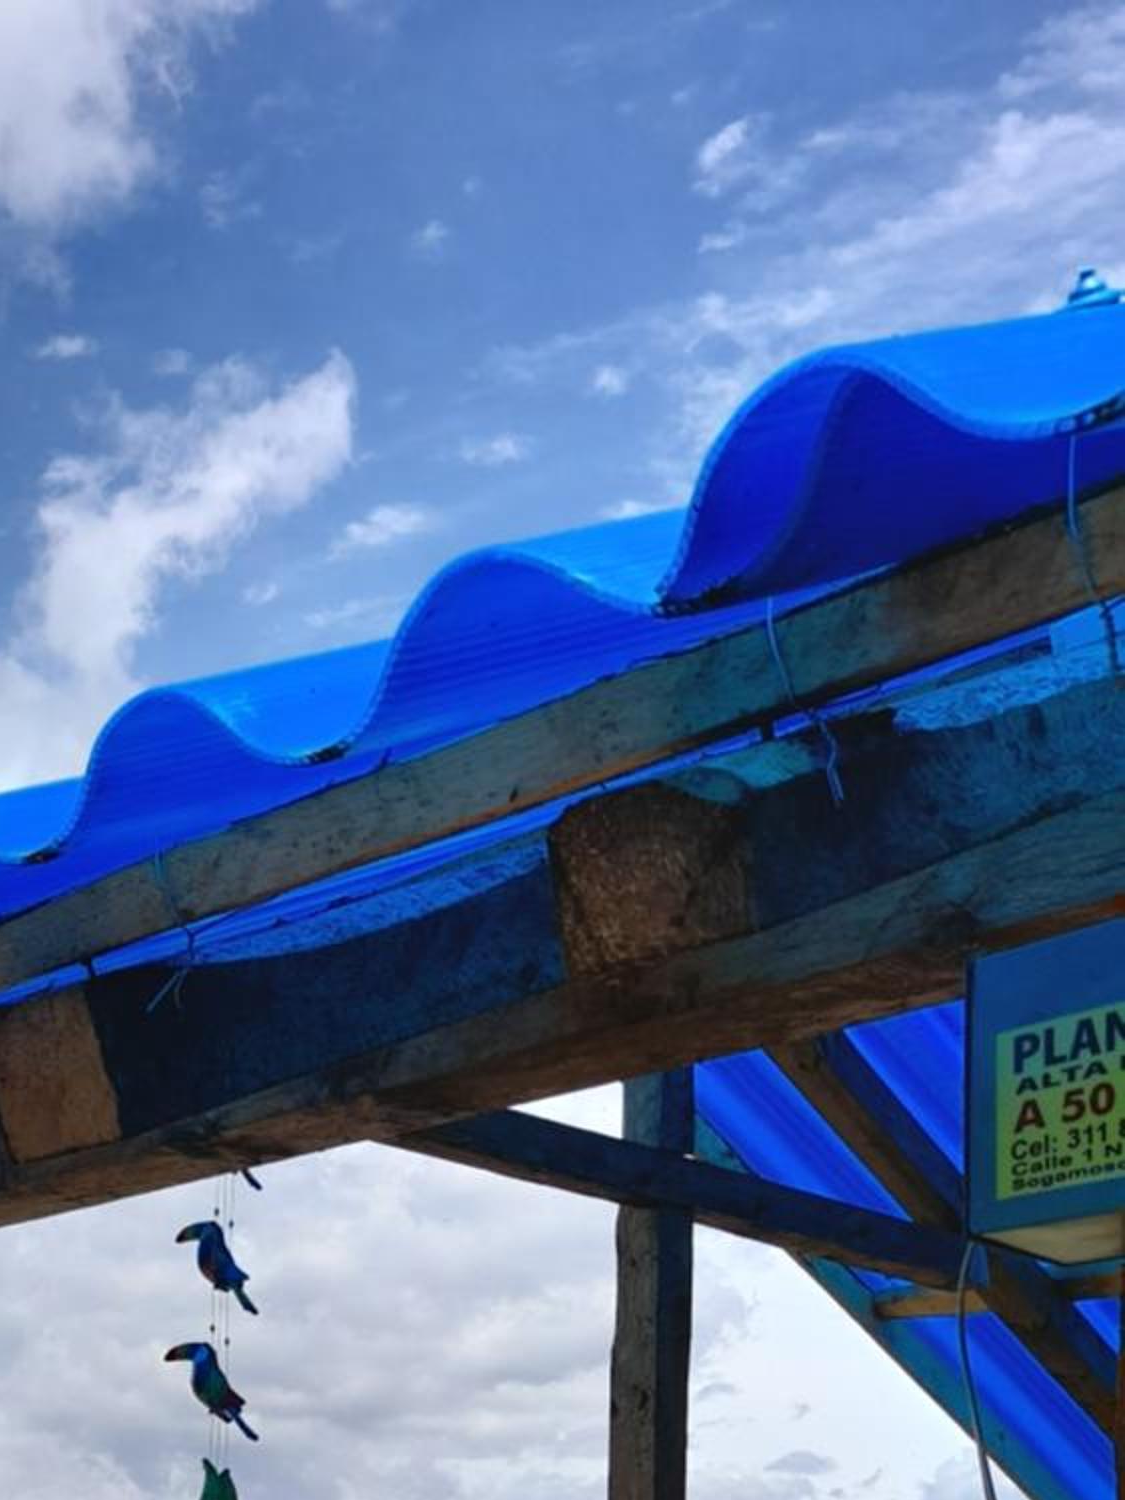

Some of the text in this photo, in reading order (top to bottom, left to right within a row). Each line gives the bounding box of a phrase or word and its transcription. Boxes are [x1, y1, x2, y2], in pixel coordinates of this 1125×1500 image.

[1013, 1010, 1125, 1075] PLAN
[1017, 1061, 1109, 1095] ALTA
[1015, 1083, 1116, 1133] A 50
[1011, 1134, 1058, 1160] Cel:
[1067, 1121, 1107, 1148] 311
[1011, 1155, 1073, 1176] Calle
[1082, 1148, 1093, 1161] 1
